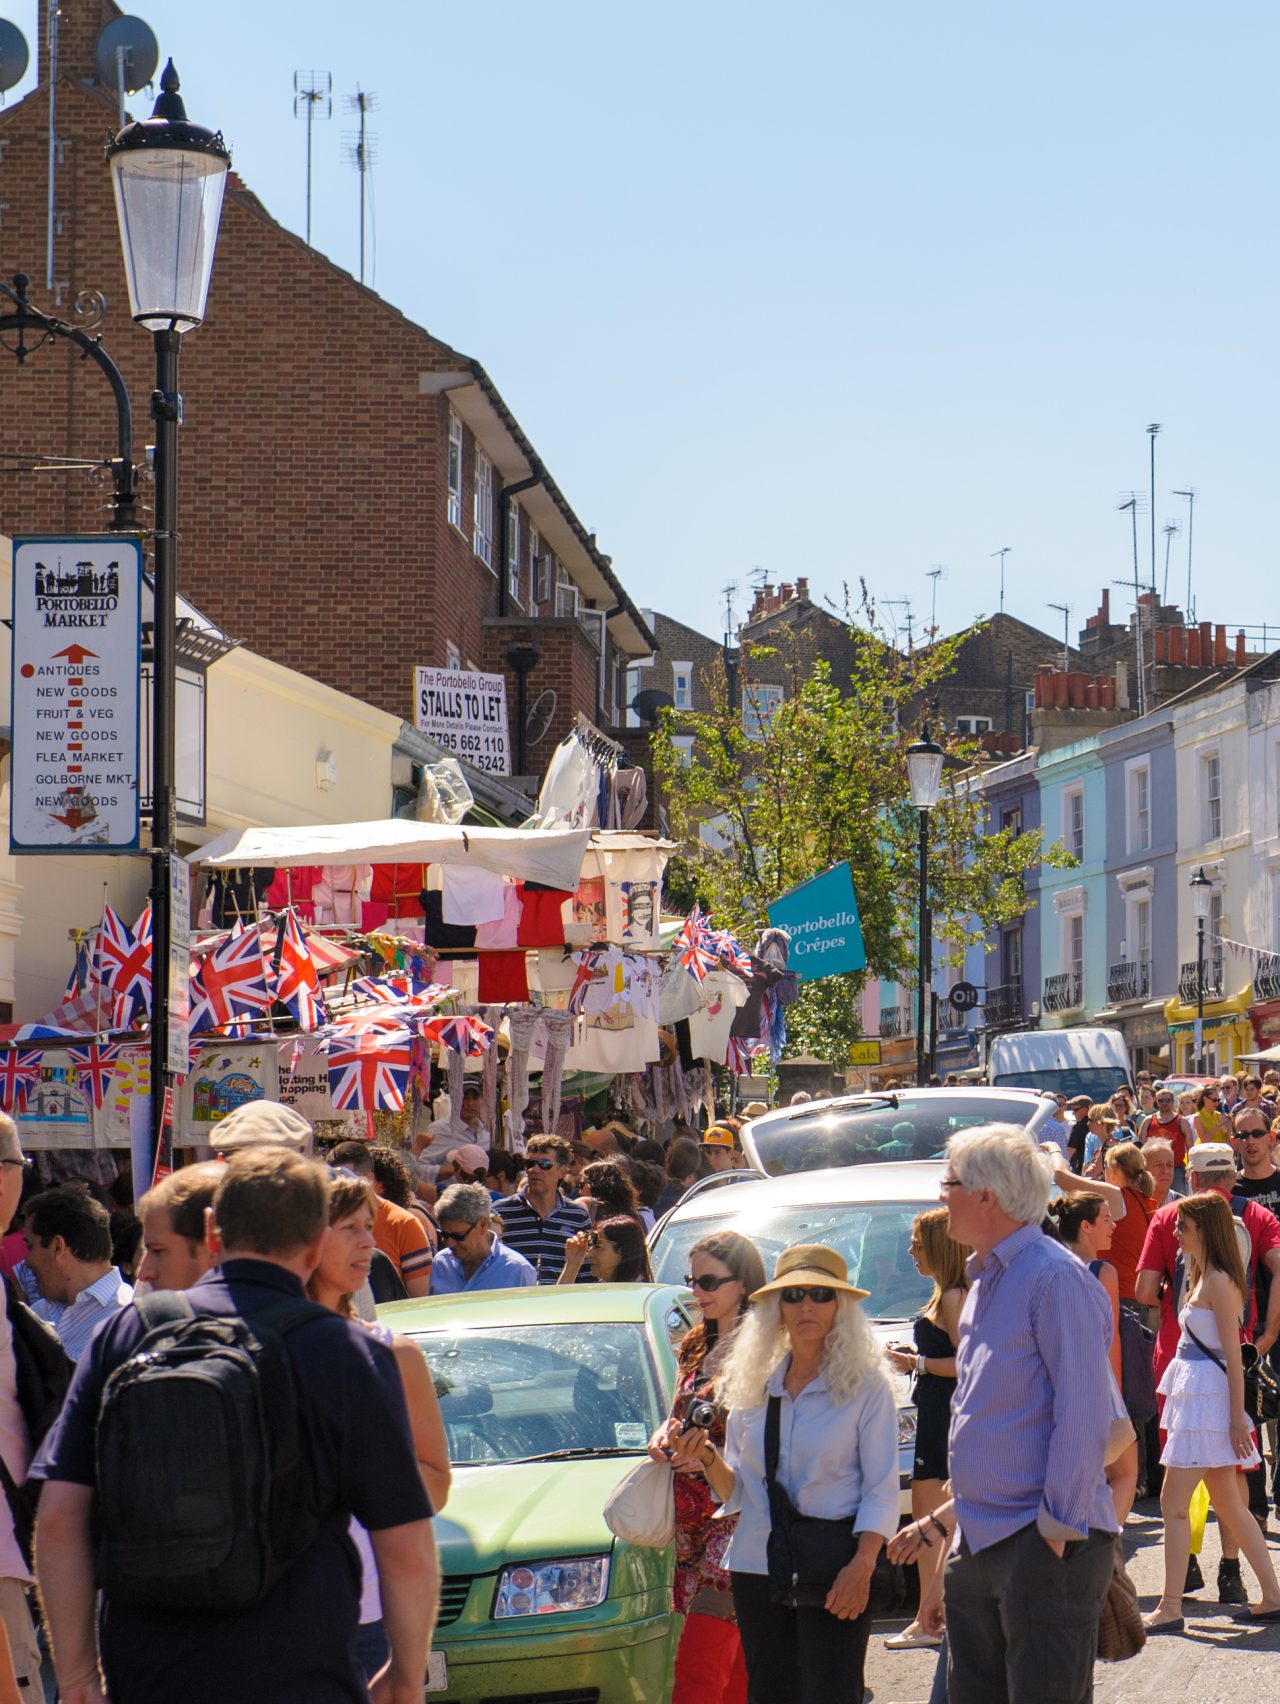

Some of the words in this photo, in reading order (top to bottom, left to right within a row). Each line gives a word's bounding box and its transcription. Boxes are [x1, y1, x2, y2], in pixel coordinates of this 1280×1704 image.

[36, 596, 118, 612] PORTOBELLO
[44, 613, 109, 628] MARKET
[37, 665, 101, 677] ANTIQUES
[419, 670, 434, 685] The
[436, 672, 477, 690] Portobello
[478, 677, 503, 696] Group
[36, 687, 65, 698] NEW
[70, 687, 118, 698] GOODS
[421, 689, 463, 719] STALLS
[464, 693, 480, 720] TO
[482, 695, 502, 723] LET
[36, 709, 71, 720] FRUIT
[76, 709, 84, 719] &
[89, 709, 114, 719] VEG
[36, 731, 65, 741] NEW
[70, 731, 118, 741] GOODS
[460, 734, 481, 752] 662
[484, 736, 505, 753] 110
[36, 752, 67, 763] FLEA
[72, 752, 124, 763] MARKET
[478, 755, 505, 771] 5242
[35, 774, 103, 785] GOLBORNE
[106, 774, 132, 784] MKT
[35, 796, 64, 807] NEW
[70, 797, 118, 807] GOODS
[777, 912, 856, 937] Portobello
[794, 937, 846, 955] Crêpes
[953, 990, 976, 1004] Oi!
